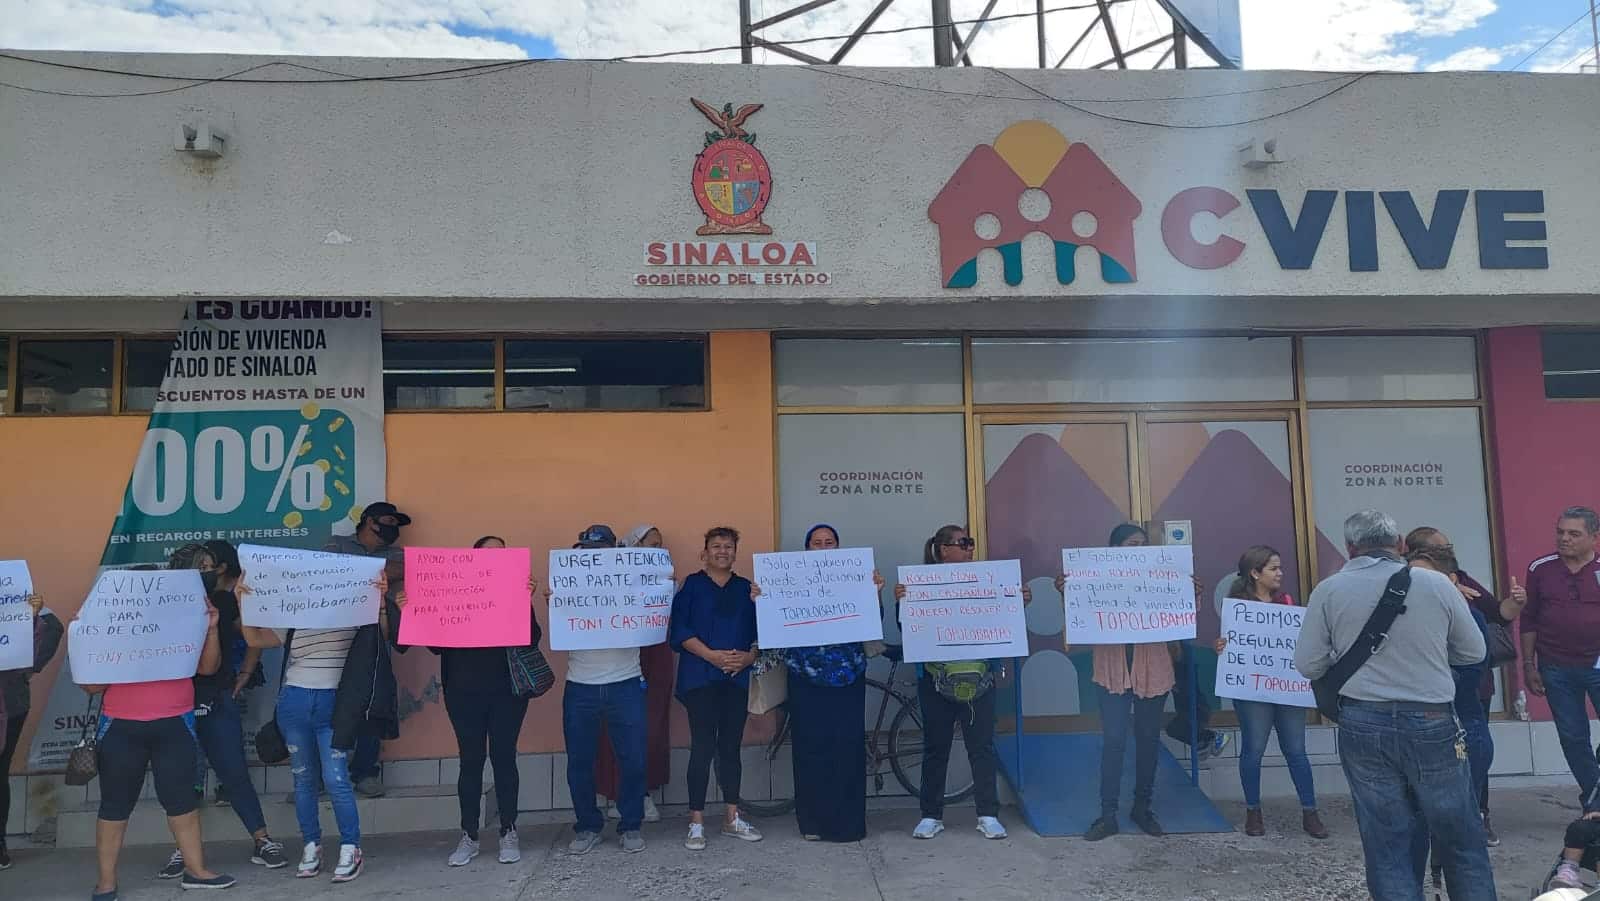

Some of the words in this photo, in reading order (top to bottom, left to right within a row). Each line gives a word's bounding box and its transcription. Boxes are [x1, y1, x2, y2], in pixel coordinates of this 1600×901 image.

[1161, 186, 1549, 271] CVIVE
[648, 242, 814, 265] SINALOA
[635, 273, 721, 285] GOBIERNO
[727, 273, 756, 285] DEL
[764, 273, 829, 285] ESTADO
[217, 330, 241, 350] DE
[246, 328, 327, 350] VIVIENDA
[213, 355, 237, 377] DE
[241, 355, 317, 377] SINALOA
[252, 387, 309, 401] HASTA
[314, 387, 336, 399] DE
[340, 387, 365, 398] UN
[118, 424, 326, 516] 00%
[820, 468, 924, 481] COORDINACIÓN
[1344, 461, 1443, 474] COORDINACIÓN
[1345, 477, 1387, 487] ZONA
[1393, 476, 1444, 486] NORTE
[820, 484, 863, 495] ZONA
[870, 484, 924, 494] NORTE
[110, 534, 130, 545] EN
[136, 531, 212, 543] RECARGOS
[217, 530, 226, 540] E
[230, 527, 310, 539] INTERESES
[452, 553, 474, 564] CON
[558, 553, 603, 570] URGE
[794, 557, 807, 568] el
[1067, 549, 1081, 562] El
[1156, 549, 1173, 564] de
[478, 569, 494, 578] DE
[1148, 567, 1179, 580] MOYA
[97, 576, 167, 594] CVIVE
[553, 575, 578, 589] POR
[585, 573, 633, 587] PARTE
[640, 574, 664, 586] DEL
[1068, 583, 1081, 592] no
[779, 588, 811, 599] tema
[817, 585, 834, 598] de
[158, 594, 196, 606] APOYO
[554, 594, 618, 608] DIRECTOR
[624, 595, 638, 607] DE
[1069, 596, 1080, 609] el
[1087, 594, 1118, 608] tema
[1123, 595, 1137, 609] de
[1144, 595, 1193, 610] vivienda
[109, 611, 144, 624] PARA
[1233, 602, 1302, 629] PEDIMOS
[107, 625, 125, 636] DE
[131, 623, 161, 636] CASA
[568, 617, 603, 631] TONI
[911, 624, 926, 633] DE
[1071, 616, 1087, 630] de
[1227, 651, 1246, 665] DE
[1253, 655, 1274, 667] LOS
[1225, 673, 1245, 686] EN
